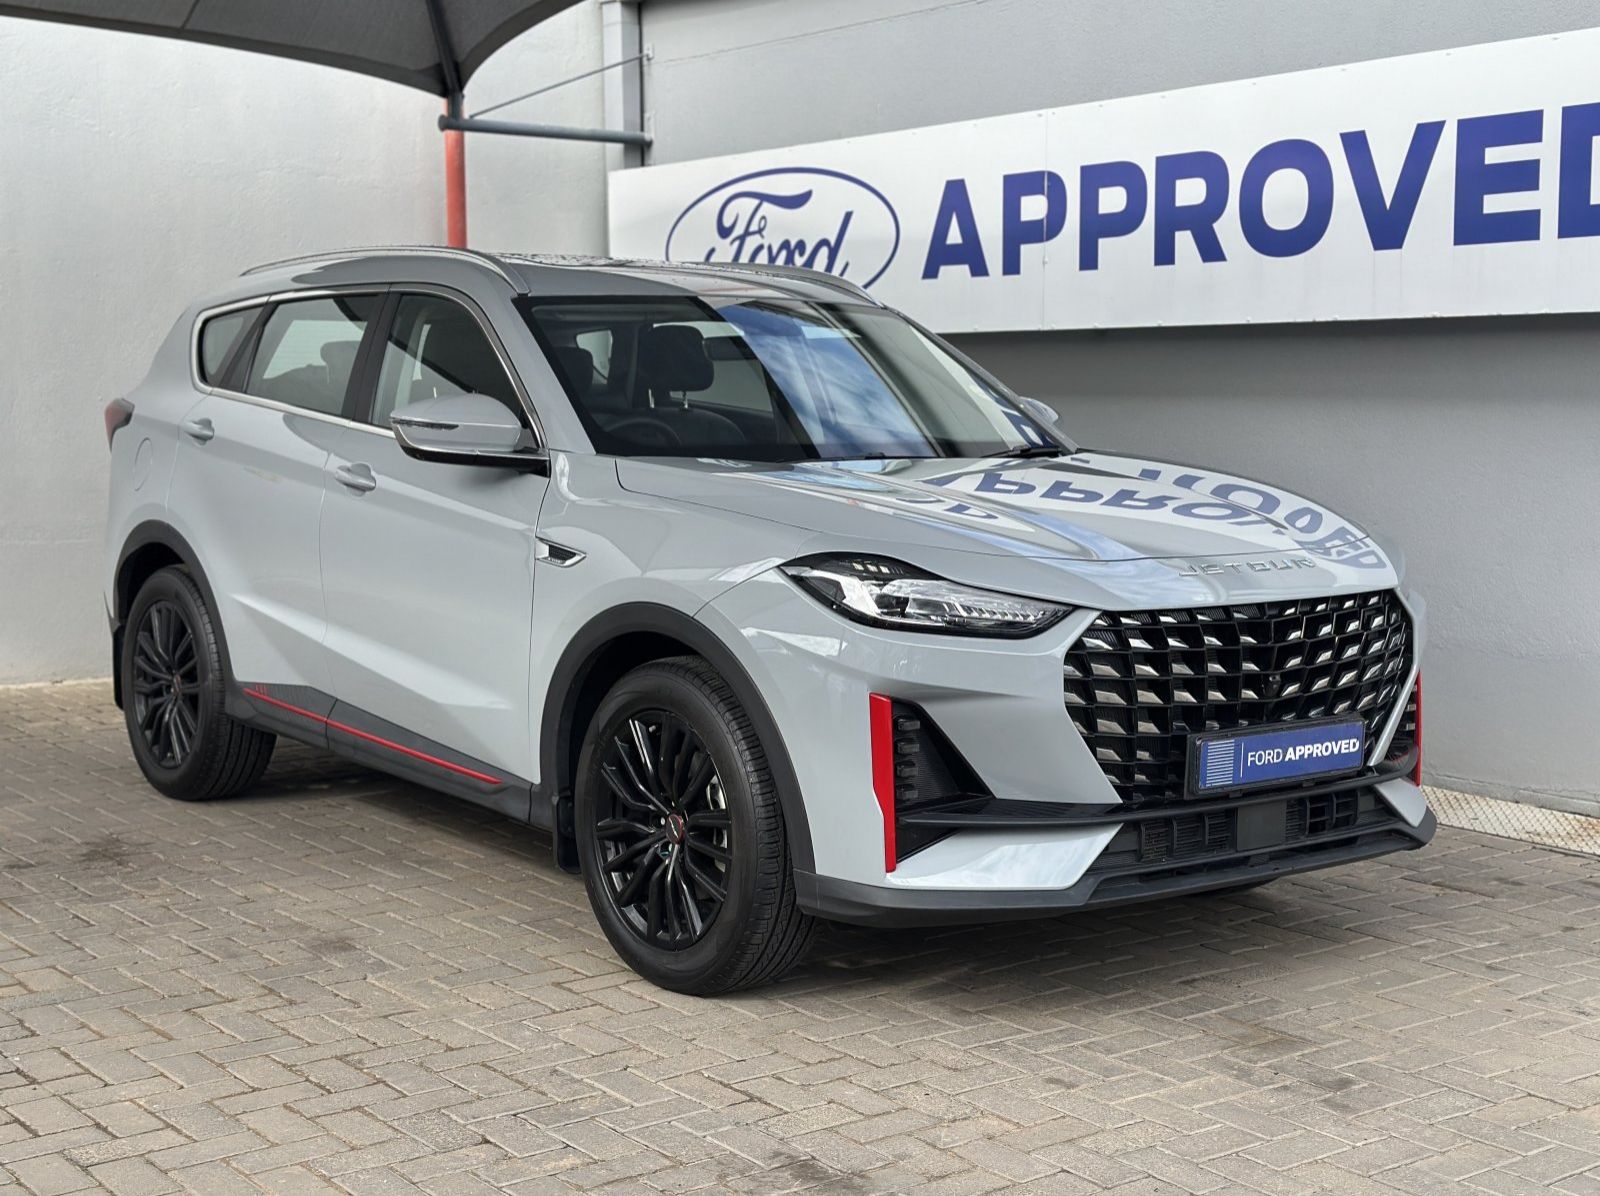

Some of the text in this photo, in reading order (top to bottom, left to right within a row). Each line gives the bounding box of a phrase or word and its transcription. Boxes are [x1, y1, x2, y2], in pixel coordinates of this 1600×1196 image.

[1178, 558, 1316, 577] JETOUR
[1247, 738, 1360, 767] FORD APPROVED
